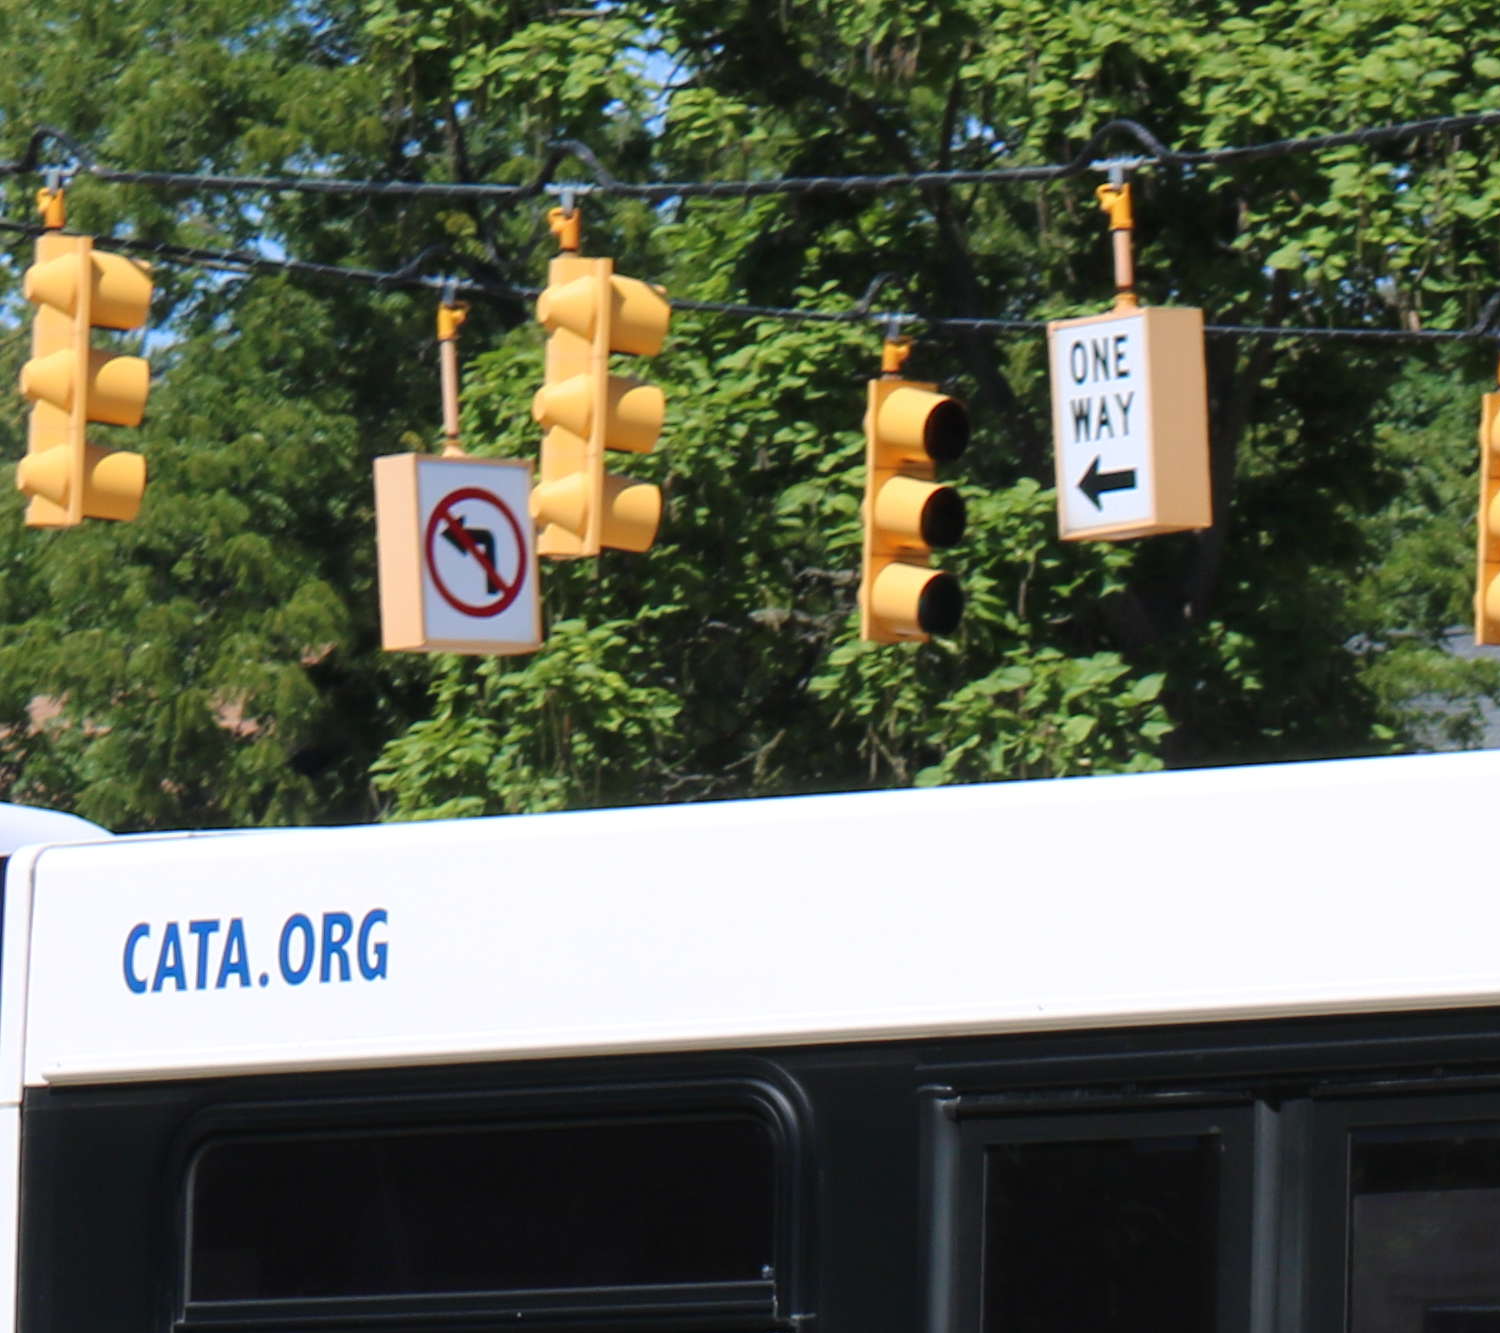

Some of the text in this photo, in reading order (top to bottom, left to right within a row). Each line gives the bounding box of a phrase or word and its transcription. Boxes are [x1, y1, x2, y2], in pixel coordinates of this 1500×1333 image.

[1069, 334, 1131, 386] ONE
[1069, 391, 1135, 444] WAY
[122, 908, 390, 994] CATA.ORG
